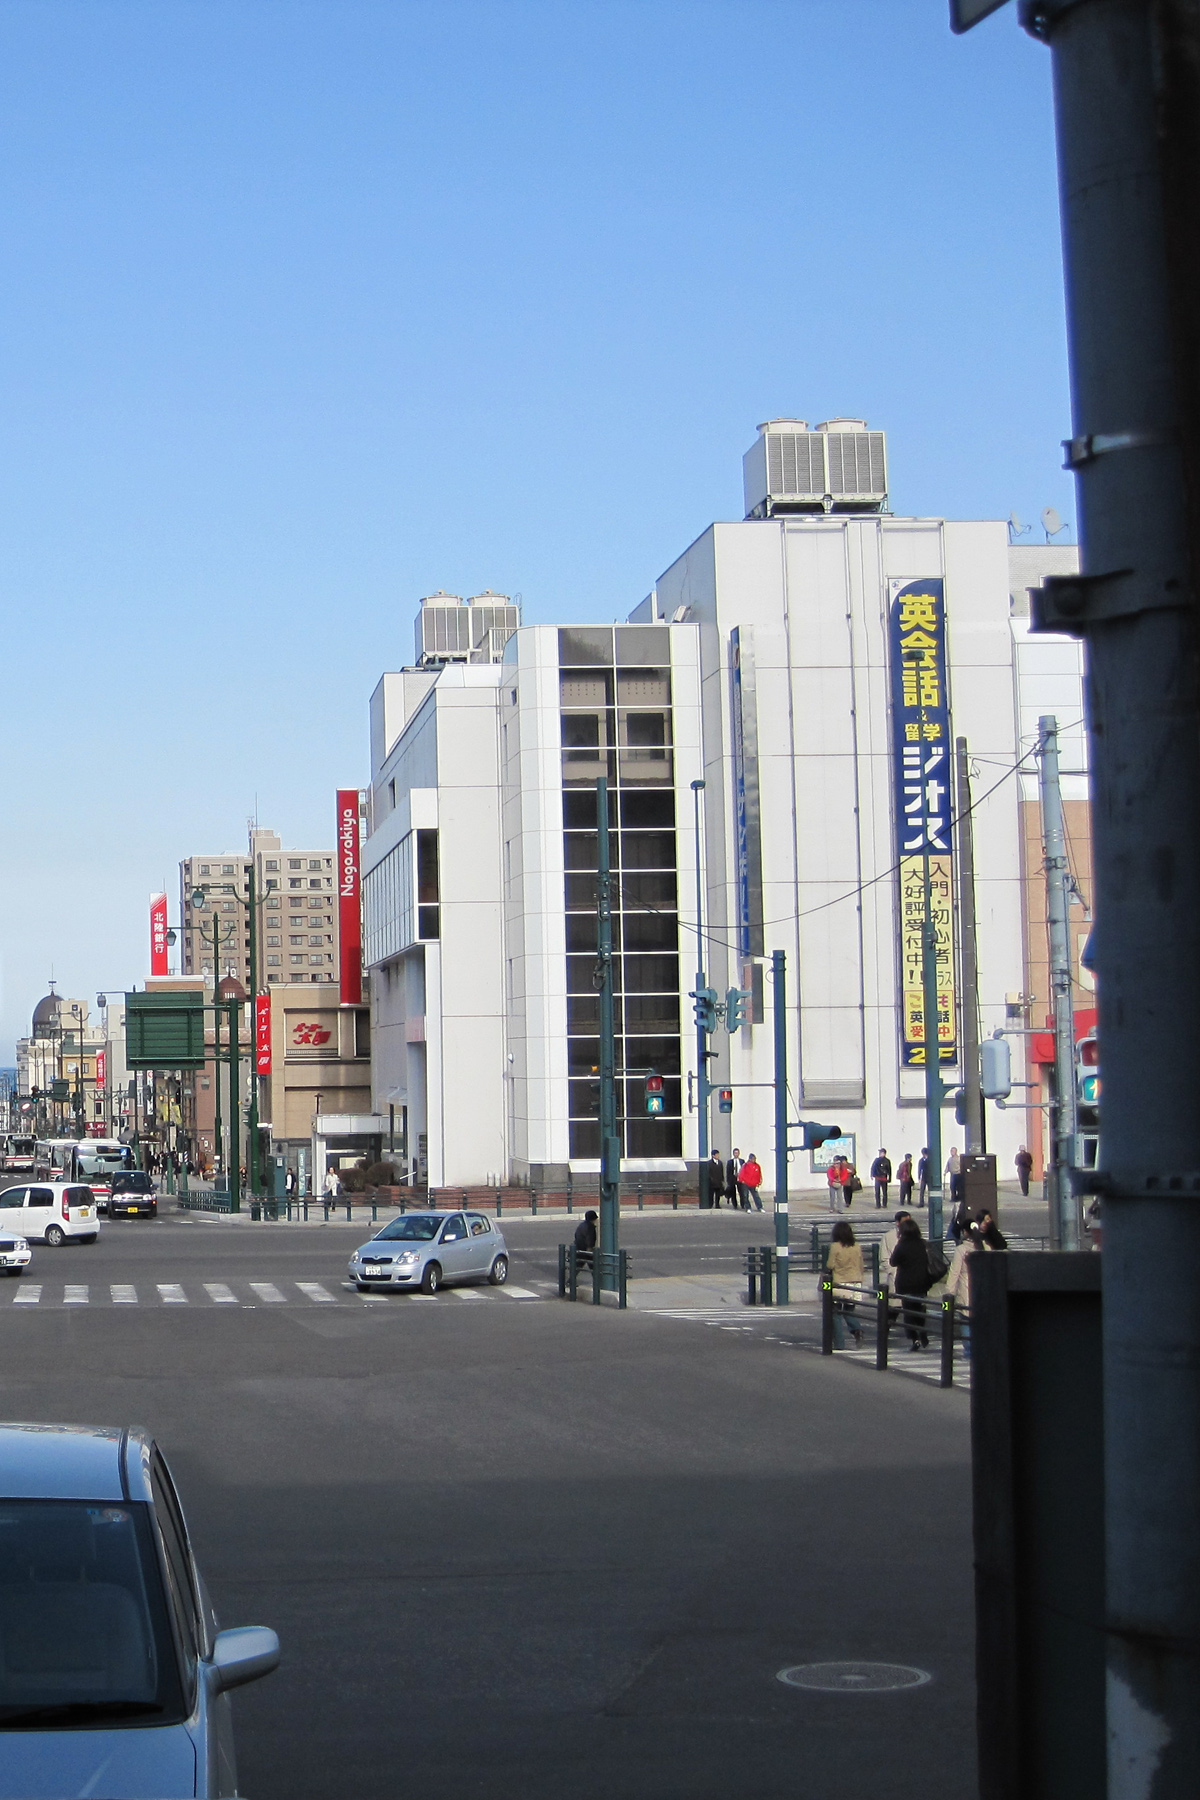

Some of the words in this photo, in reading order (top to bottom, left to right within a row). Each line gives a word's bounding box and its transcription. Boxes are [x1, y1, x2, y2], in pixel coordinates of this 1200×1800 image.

[899, 593, 939, 707] 英会話
[904, 723, 941, 741] 留学
[902, 746, 948, 850] ジオス
[340, 808, 358, 896] Nagasakiya
[154, 911, 164, 954] 北陸銀行
[909, 994, 949, 1008] こも
[910, 1010, 950, 1023] 英話
[910, 1025, 951, 1037] 受中
